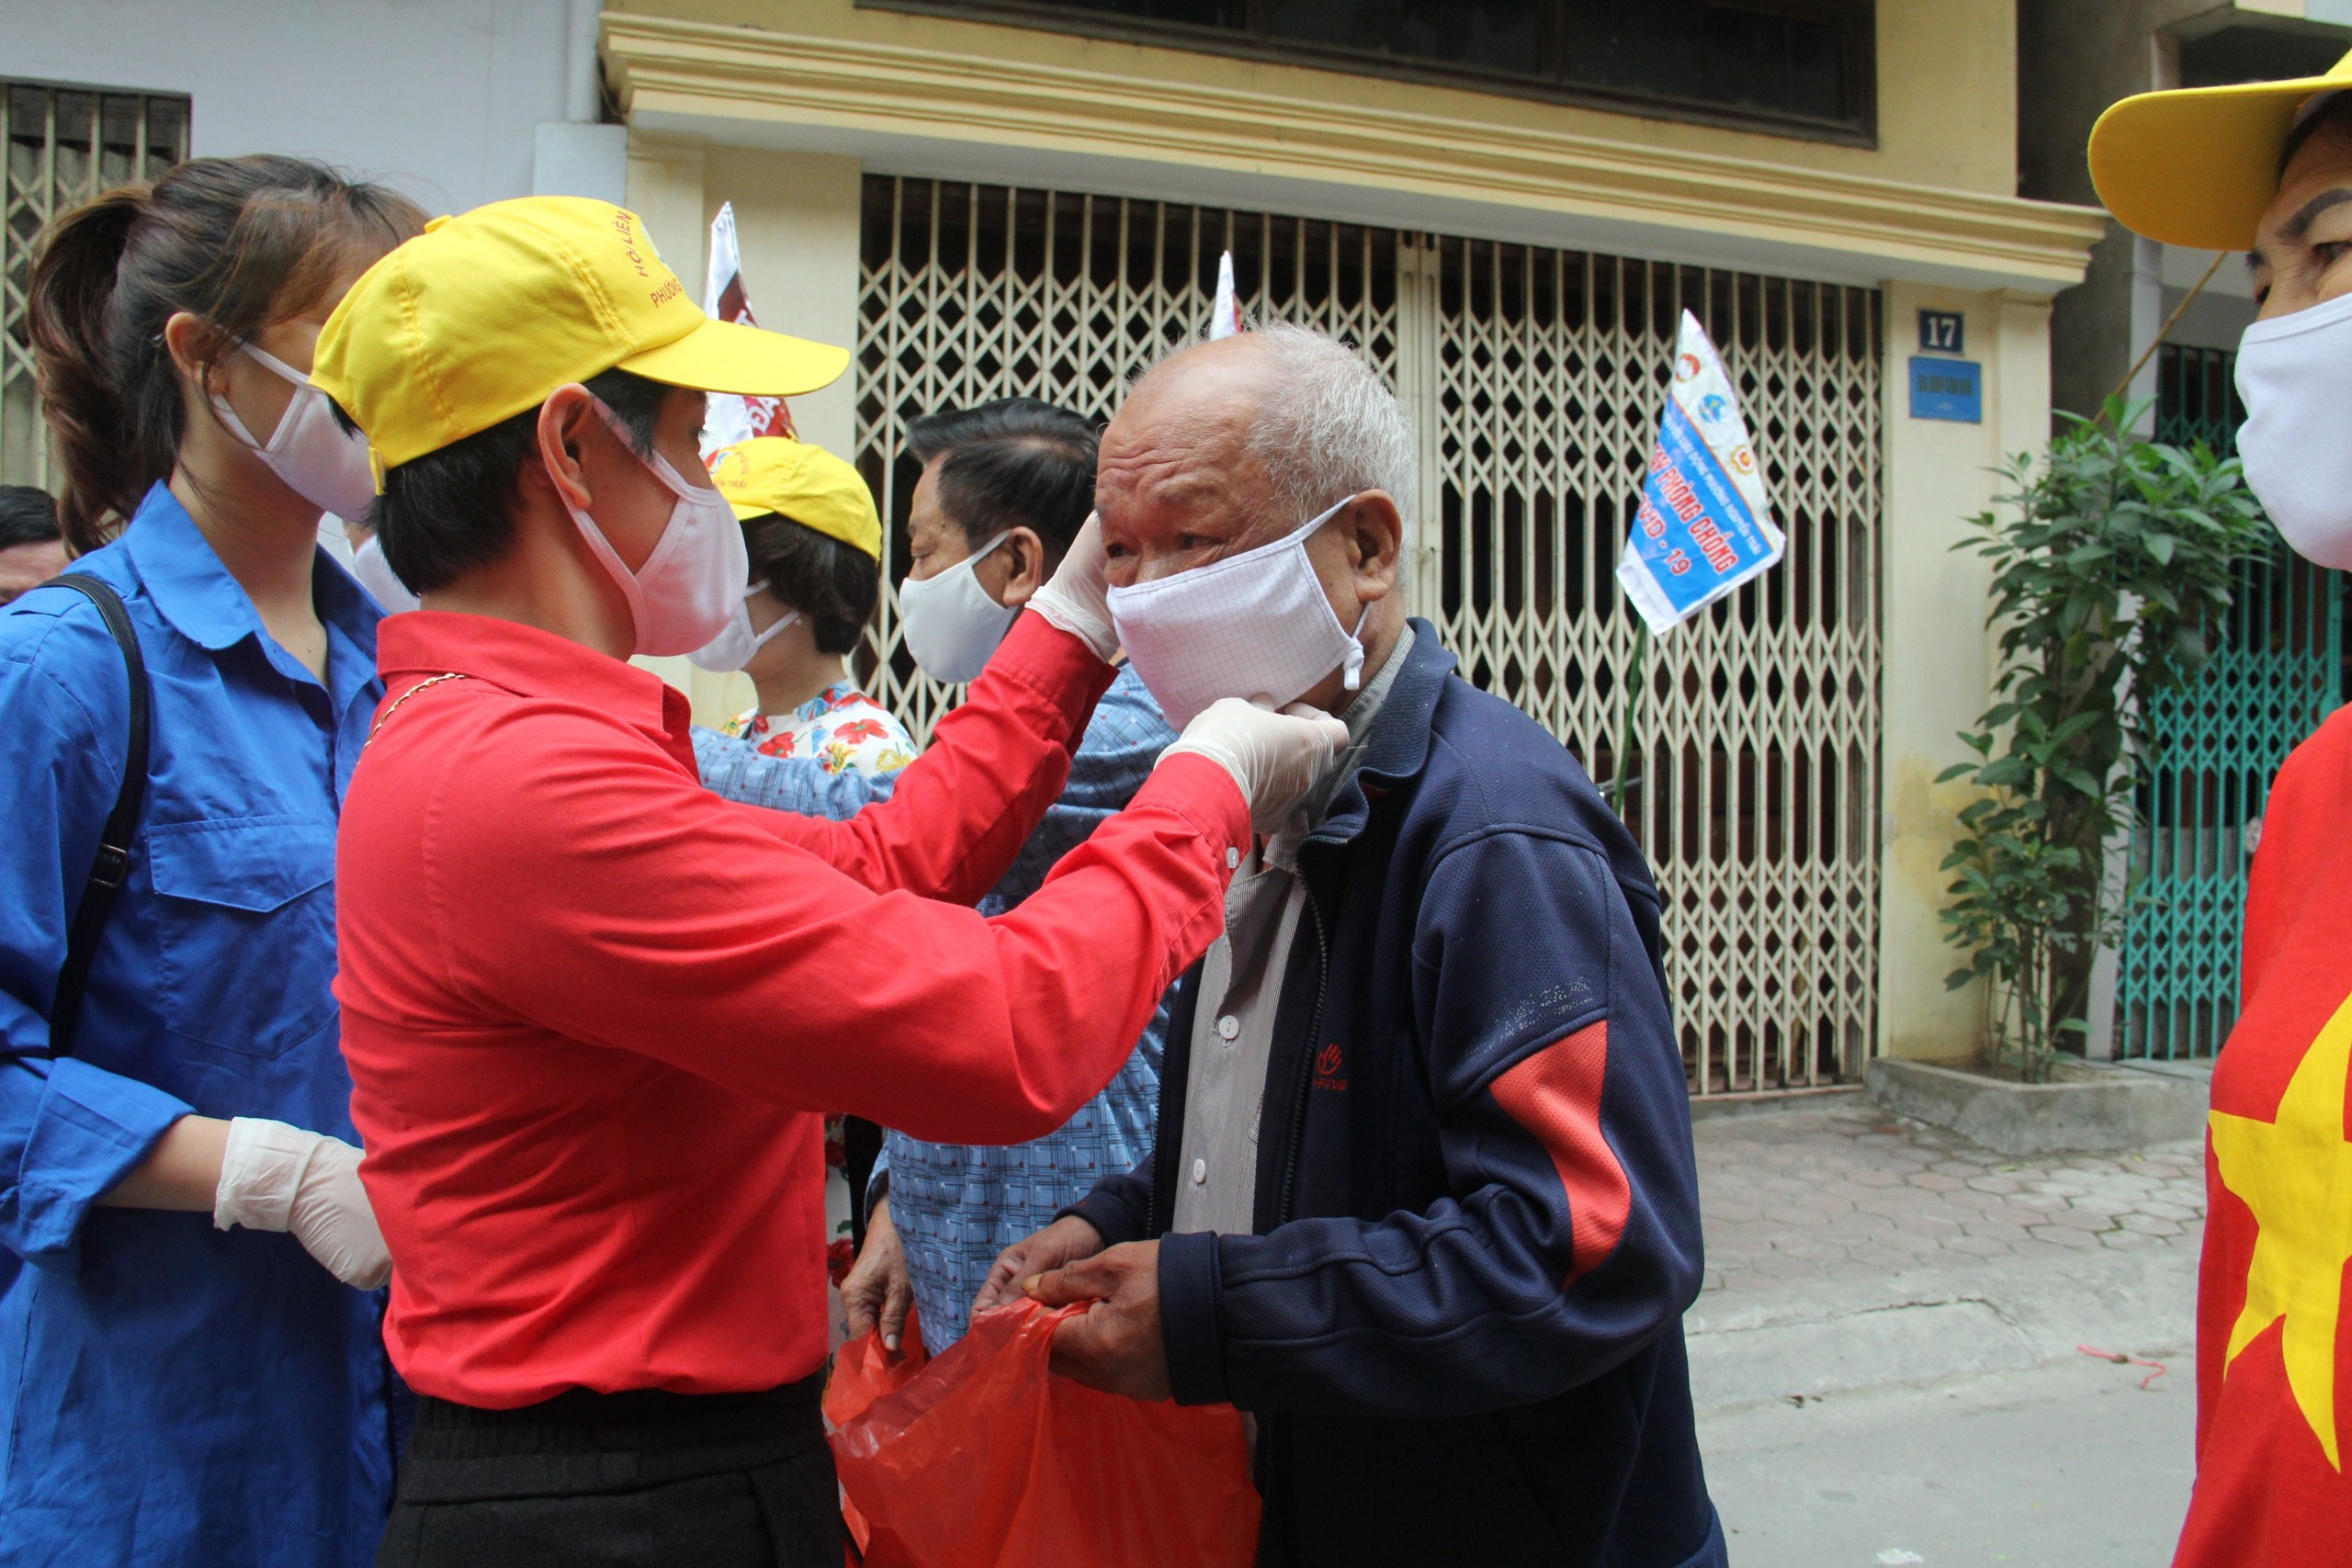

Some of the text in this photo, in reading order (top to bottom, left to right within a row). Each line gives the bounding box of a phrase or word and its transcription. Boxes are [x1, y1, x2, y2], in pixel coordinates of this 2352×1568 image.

[1928, 316, 1956, 347] 17
[1655, 467, 1704, 523] PHÒNG
[1689, 516, 1738, 574] CHỐNG
[1665, 548, 1690, 575] 19
